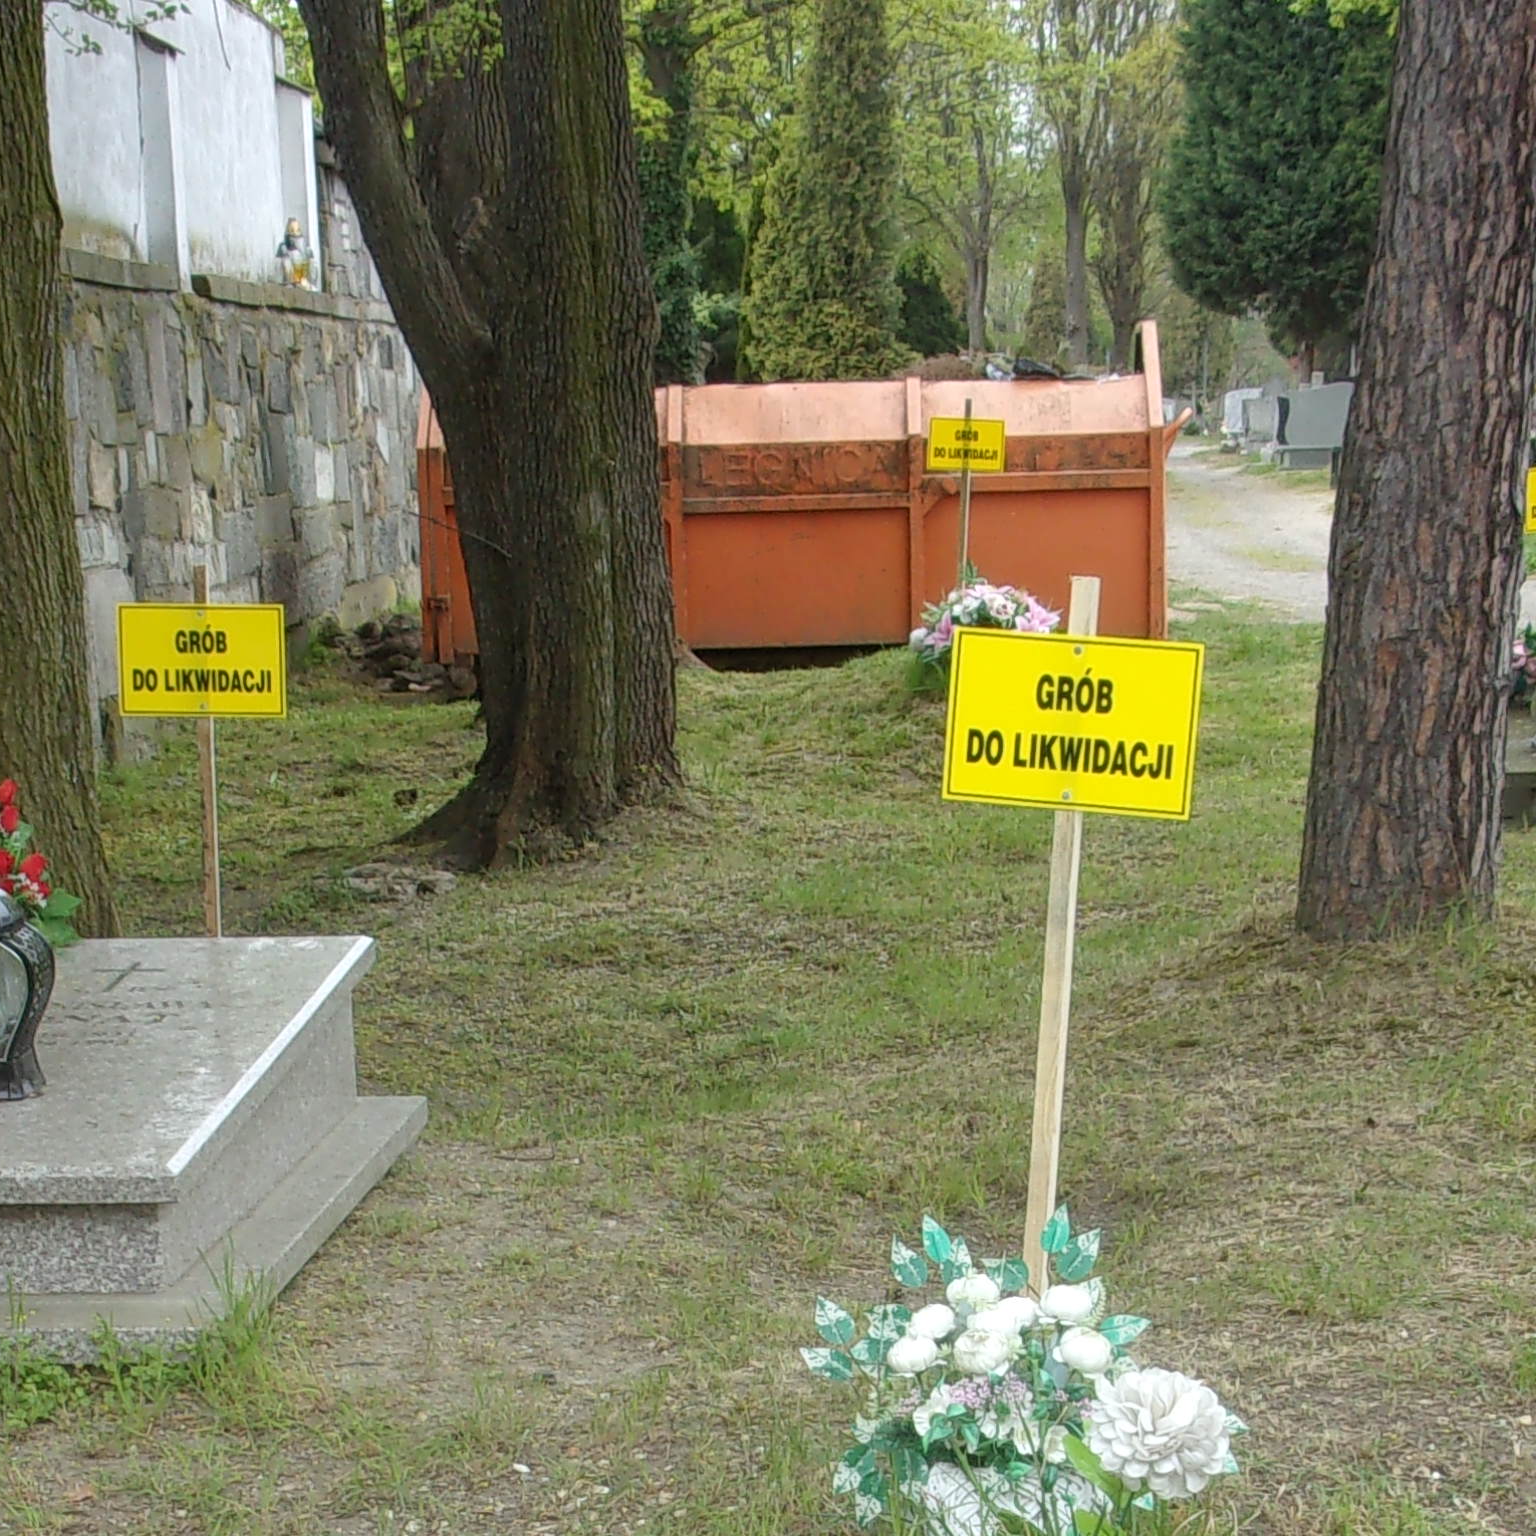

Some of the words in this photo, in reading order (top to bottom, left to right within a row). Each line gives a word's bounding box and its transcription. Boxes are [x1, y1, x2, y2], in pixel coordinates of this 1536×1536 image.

[955, 427, 979, 441] GRÓB
[934, 447, 946, 458] DO
[948, 448, 998, 460] LIKWIDACJI
[175, 628, 228, 654] GRÓB
[133, 669, 158, 693] DO
[164, 669, 272, 694] LIKWIDACJI
[1036, 667, 1113, 714] GRÓB
[966, 729, 1004, 766] DO
[1013, 734, 1174, 779] LIKWIDACJI
